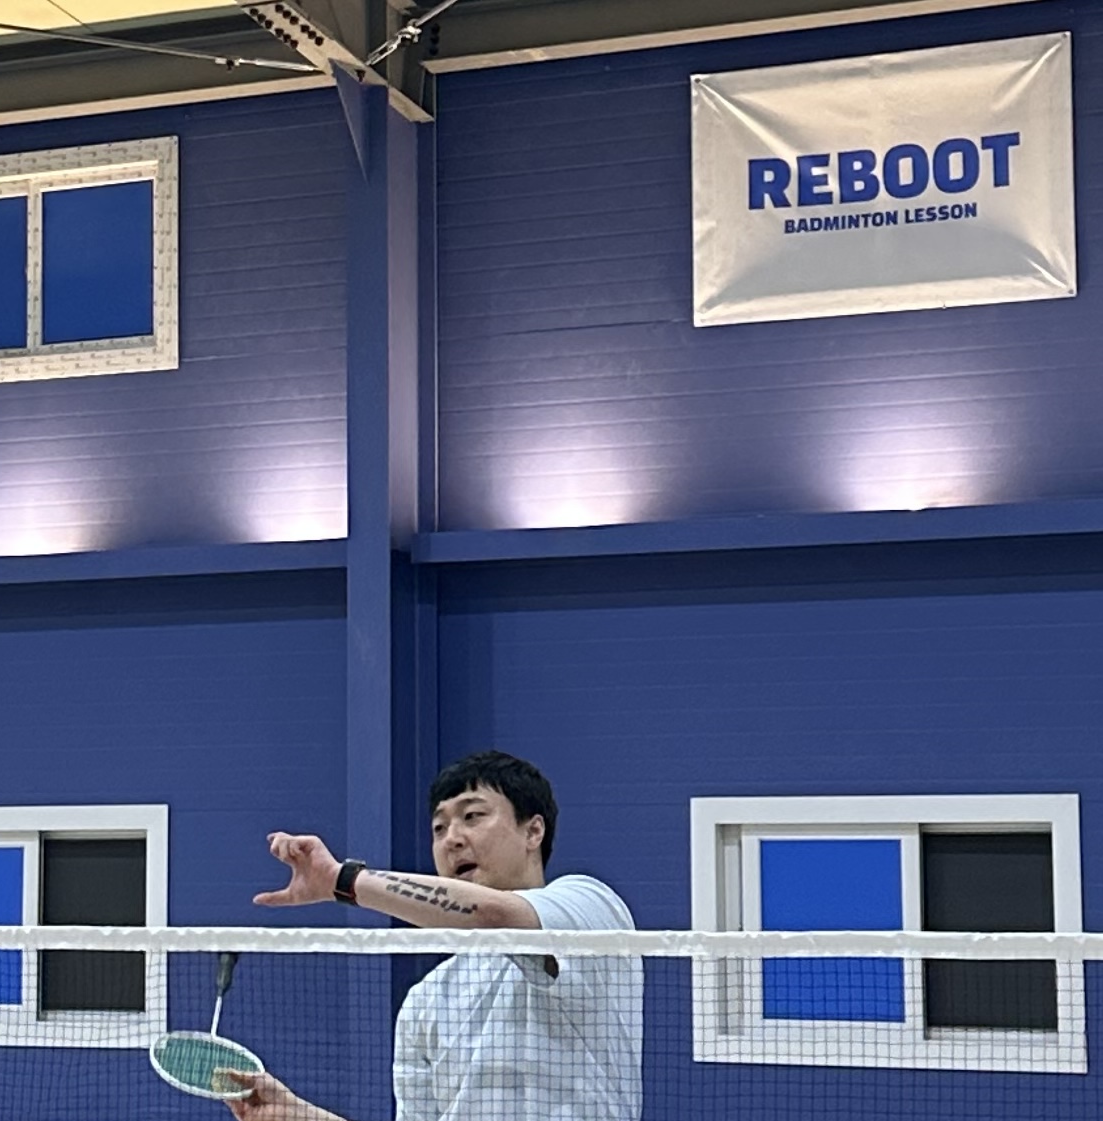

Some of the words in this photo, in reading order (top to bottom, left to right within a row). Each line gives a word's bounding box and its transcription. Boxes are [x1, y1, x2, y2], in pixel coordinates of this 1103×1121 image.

[748, 131, 1020, 210] REBOOT
[784, 210, 898, 234] BADMINTON
[905, 202, 978, 224] LESSON
